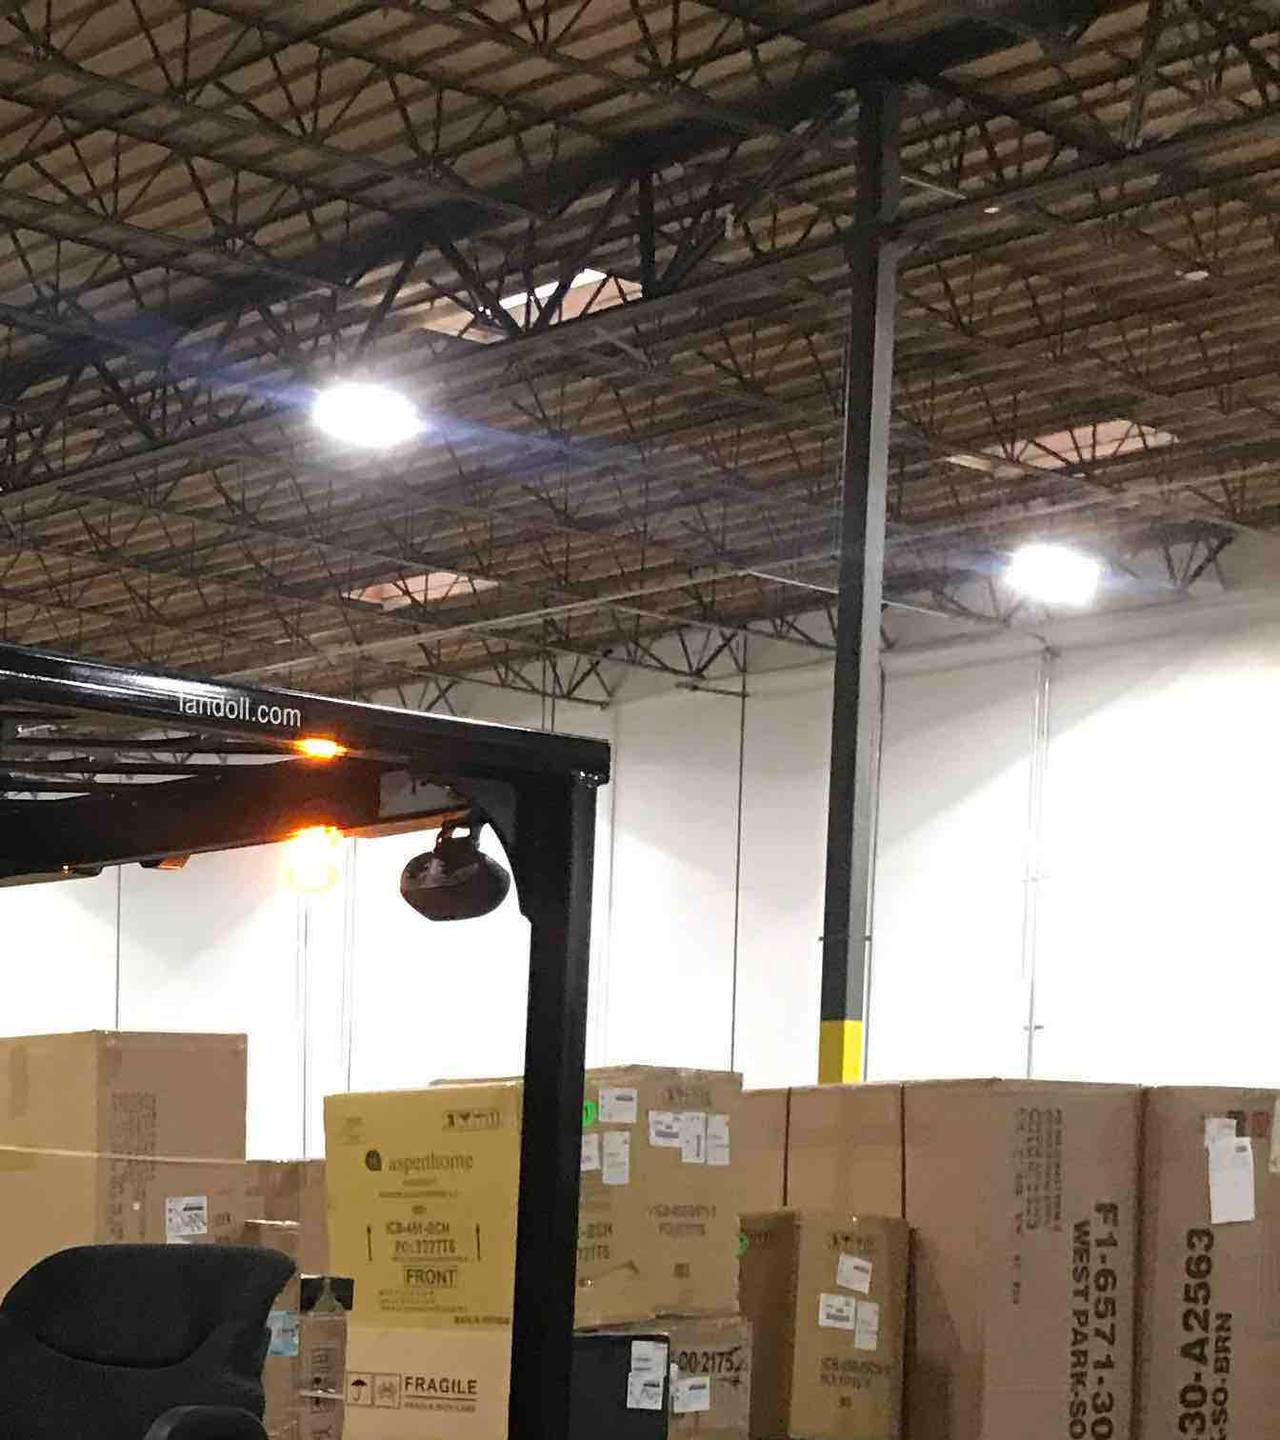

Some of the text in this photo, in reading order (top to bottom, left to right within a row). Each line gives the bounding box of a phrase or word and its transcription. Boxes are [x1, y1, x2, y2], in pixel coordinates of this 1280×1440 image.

[178, 691, 302, 728] landoll.com
[1072, 1219, 1091, 1303] WEST
[405, 1267, 457, 1286] FRONT
[404, 1375, 479, 1395] FRAGILE
